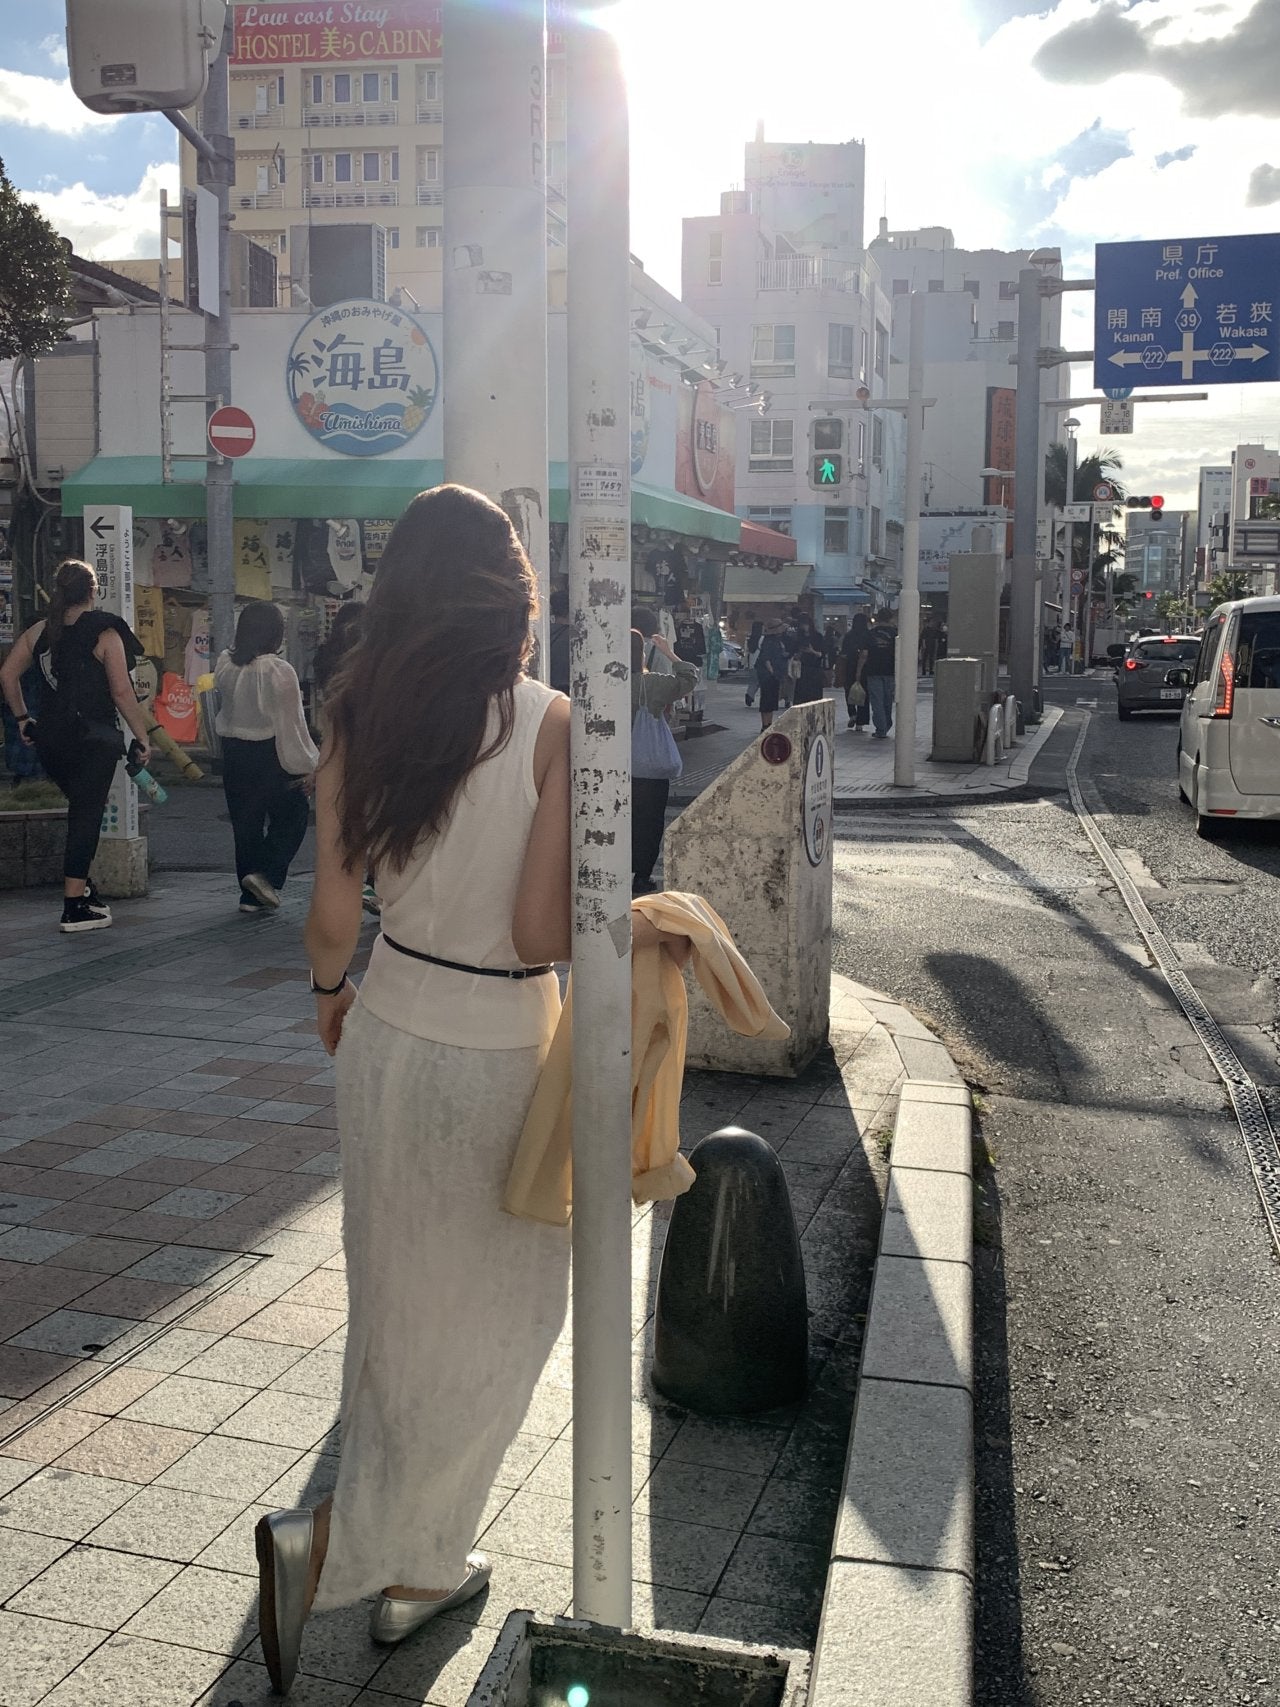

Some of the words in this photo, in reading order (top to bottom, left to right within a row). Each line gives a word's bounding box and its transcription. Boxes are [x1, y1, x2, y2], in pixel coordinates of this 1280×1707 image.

[241, 6, 288, 27] Low
[294, 7, 334, 25] cost
[340, 3, 390, 28] Stay
[237, 33, 317, 60] HOSTEL
[320, 26, 355, 58] 美ら
[359, 29, 432, 56] CABIN
[1161, 243, 1219, 267] 県庁
[1187, 266, 1224, 280] Office
[1107, 307, 1162, 329] 開南
[1179, 313, 1197, 328] 39
[1216, 301, 1273, 324] 若狭
[1113, 331, 1155, 343] Kainan
[1219, 326, 1268, 339] Wakasa
[311, 333, 411, 391] 海島
[1145, 351, 1163, 364] 222
[1213, 348, 1231, 361] 222
[319, 411, 402, 432] Umishima
[95, 543, 108, 601] 浮島通り
[134, 679, 151, 689] rion
[167, 692, 194, 705] Orion
